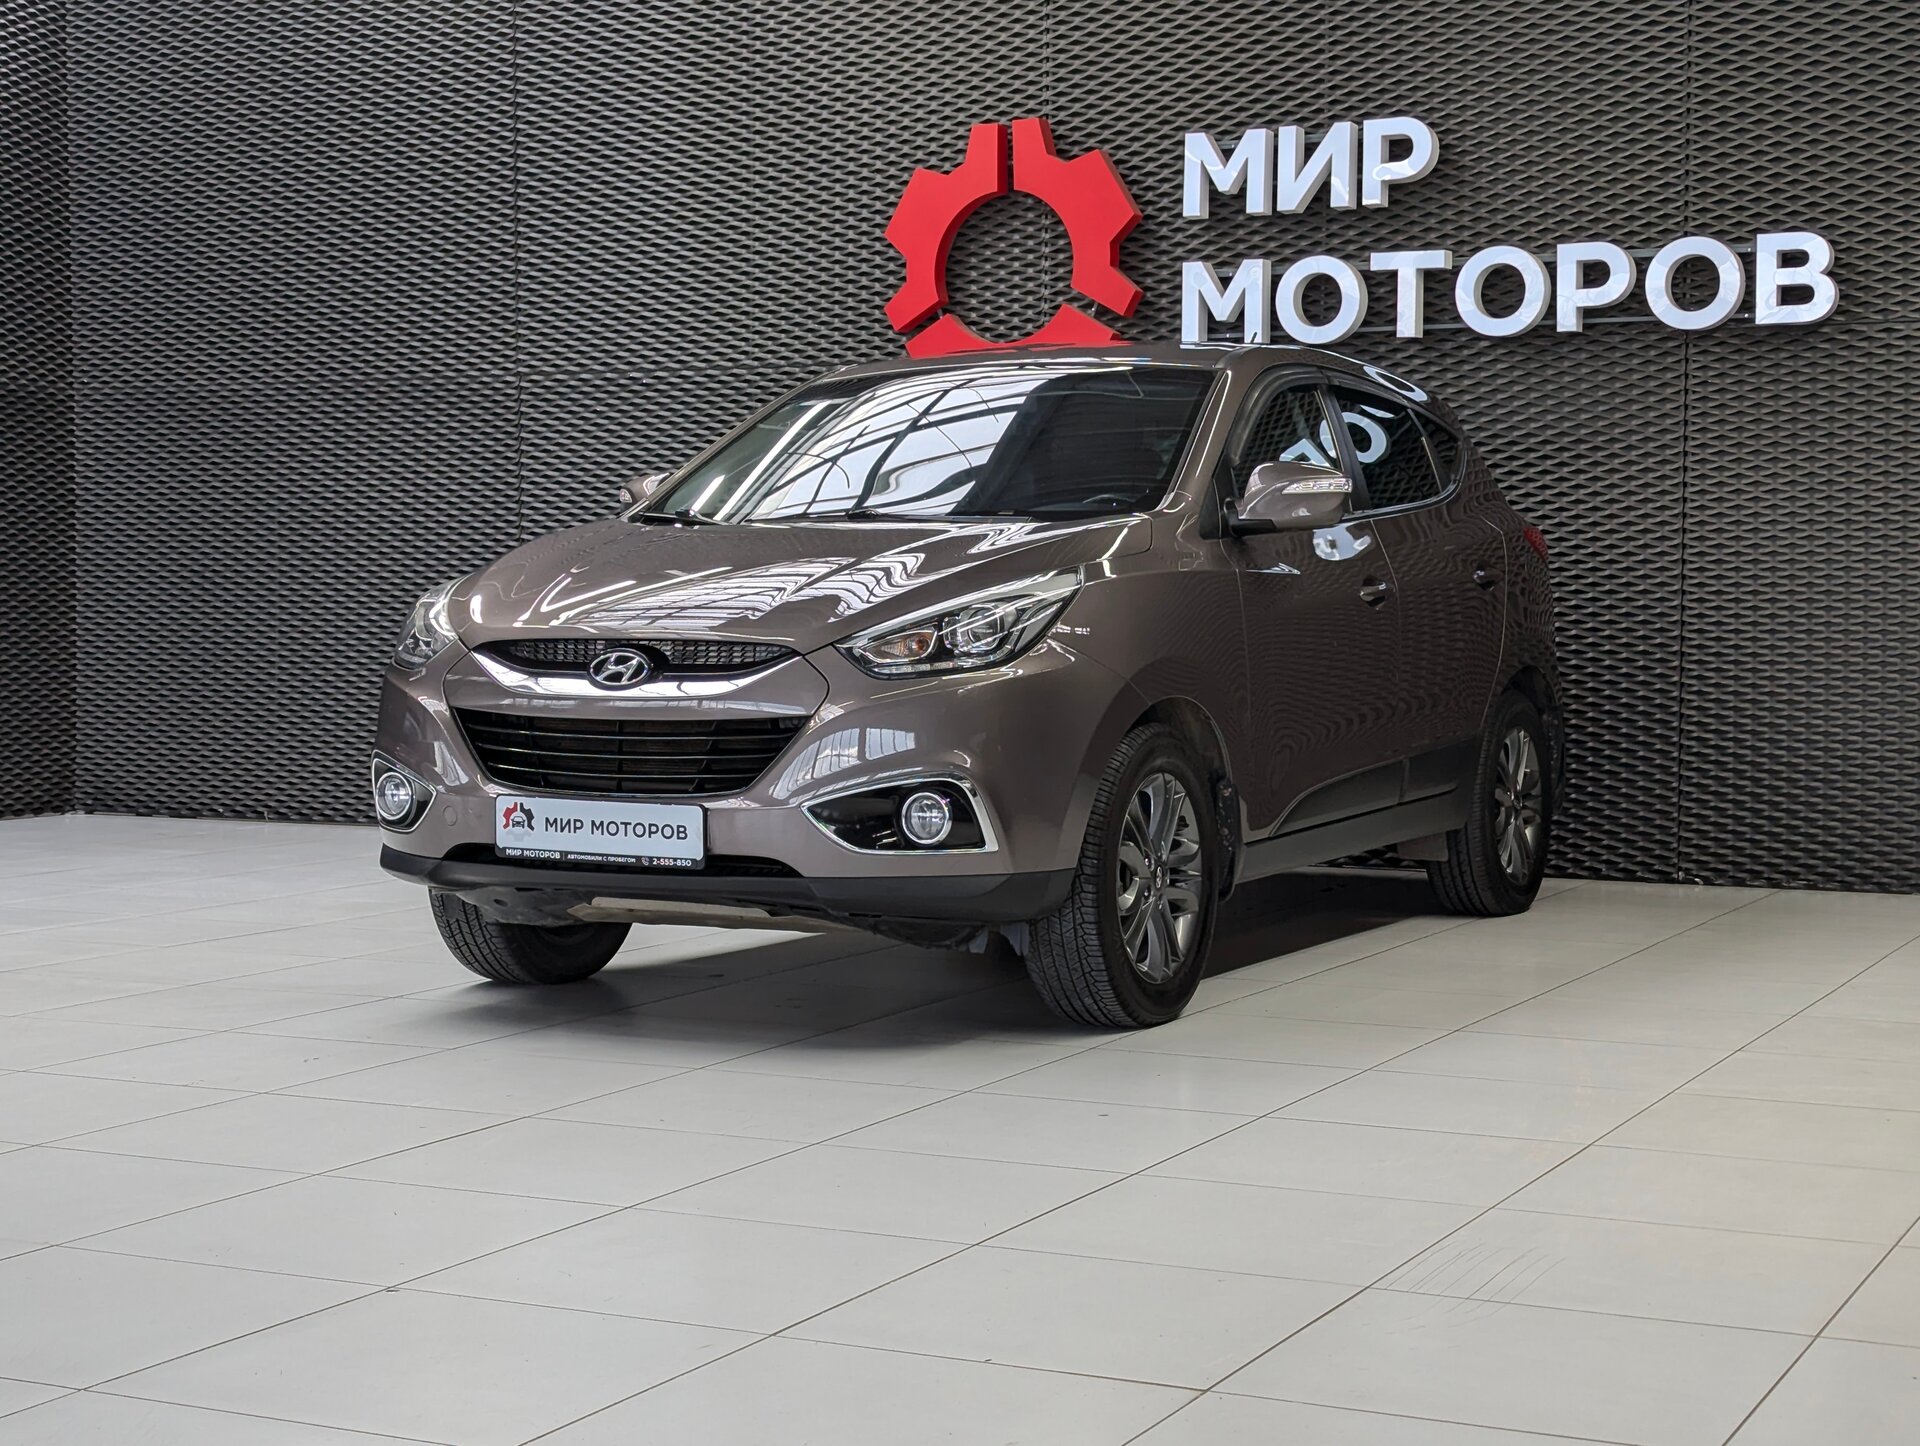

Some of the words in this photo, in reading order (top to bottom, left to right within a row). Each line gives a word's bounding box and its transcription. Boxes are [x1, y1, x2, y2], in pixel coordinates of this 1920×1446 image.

[1182, 116, 1440, 219] МИР
[1181, 231, 1839, 345] МОТОРОВ
[505, 848, 522, 857] МИР
[523, 850, 561, 859] МОТОРОВ
[567, 853, 602, 862] АВТОМОБИЛИ
[608, 855, 636, 863] ПРОБЕГОМ
[652, 858, 692, 867] 2-555-850
[544, 817, 584, 834] МИР
[591, 820, 689, 841] МОТОРОВ
